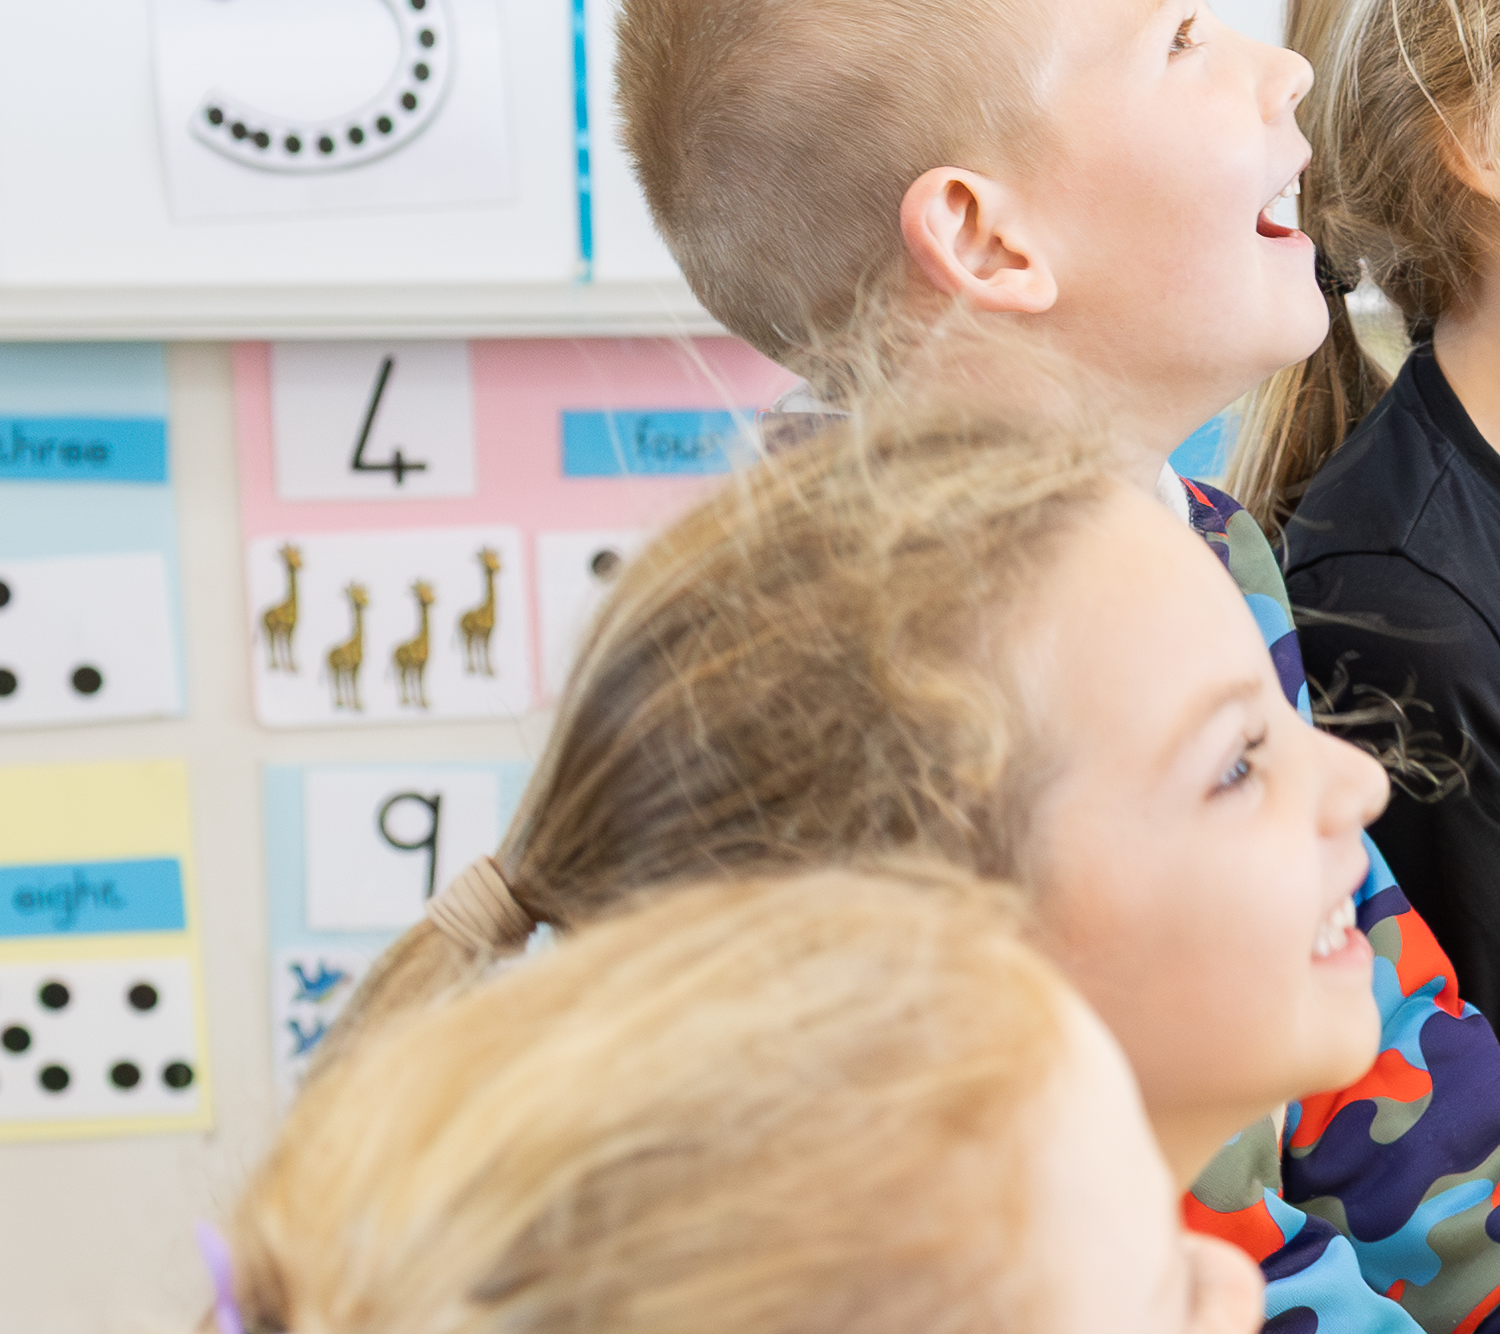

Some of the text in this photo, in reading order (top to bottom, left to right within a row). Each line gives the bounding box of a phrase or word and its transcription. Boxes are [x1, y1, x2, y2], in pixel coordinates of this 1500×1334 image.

[345, 351, 427, 485] 4
[10, 873, 128, 925] eight
[374, 789, 444, 901] 9
